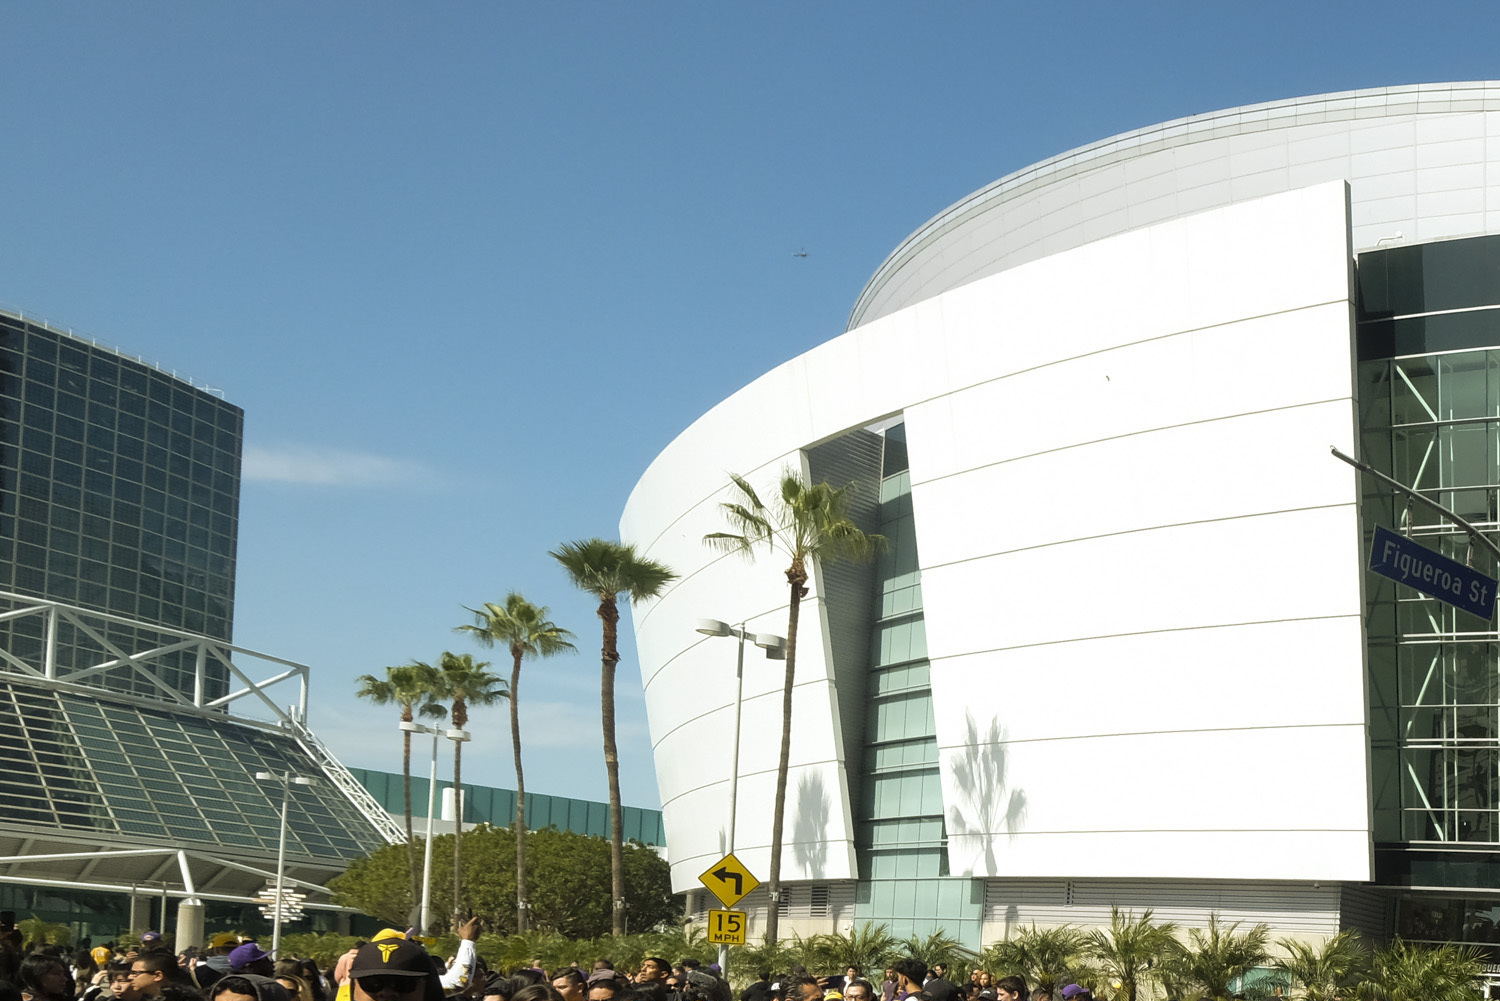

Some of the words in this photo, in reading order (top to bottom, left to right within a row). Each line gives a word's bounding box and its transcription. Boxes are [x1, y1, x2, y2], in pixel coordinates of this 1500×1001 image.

[1382, 540, 1463, 596] Figueroa
[1468, 579, 1488, 607] St
[717, 913, 741, 933] 15
[714, 933, 740, 942] MPH
